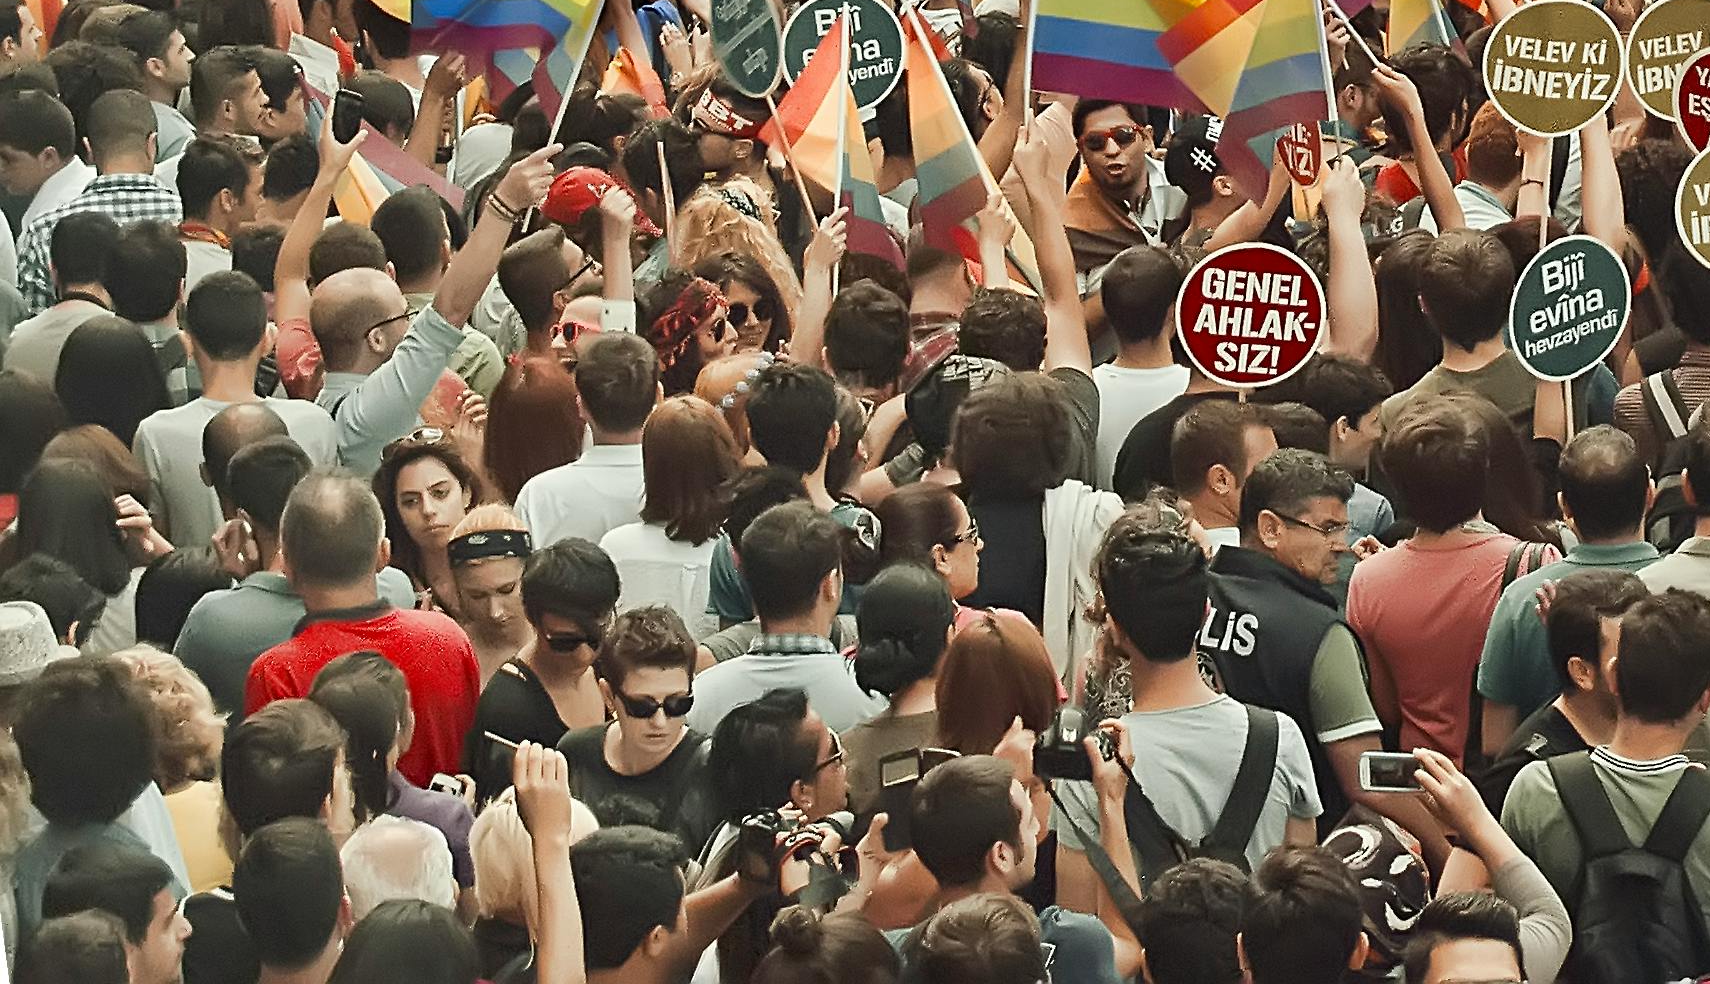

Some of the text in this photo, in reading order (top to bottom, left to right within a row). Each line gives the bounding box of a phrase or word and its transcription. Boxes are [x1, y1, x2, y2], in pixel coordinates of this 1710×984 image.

[1504, 34, 1608, 65] VELEV Kİ
[1637, 30, 1704, 60] VELEV
[1492, 58, 1612, 102] İBNEYİZ
[1202, 267, 1309, 307] GENEL
[1193, 302, 1316, 343] AHLAK-
[1529, 287, 1605, 334] evîna
[1524, 308, 1619, 359] hevzayendî
[1213, 341, 1282, 376] SIZ!
[1199, 606, 1259, 657] LİS
